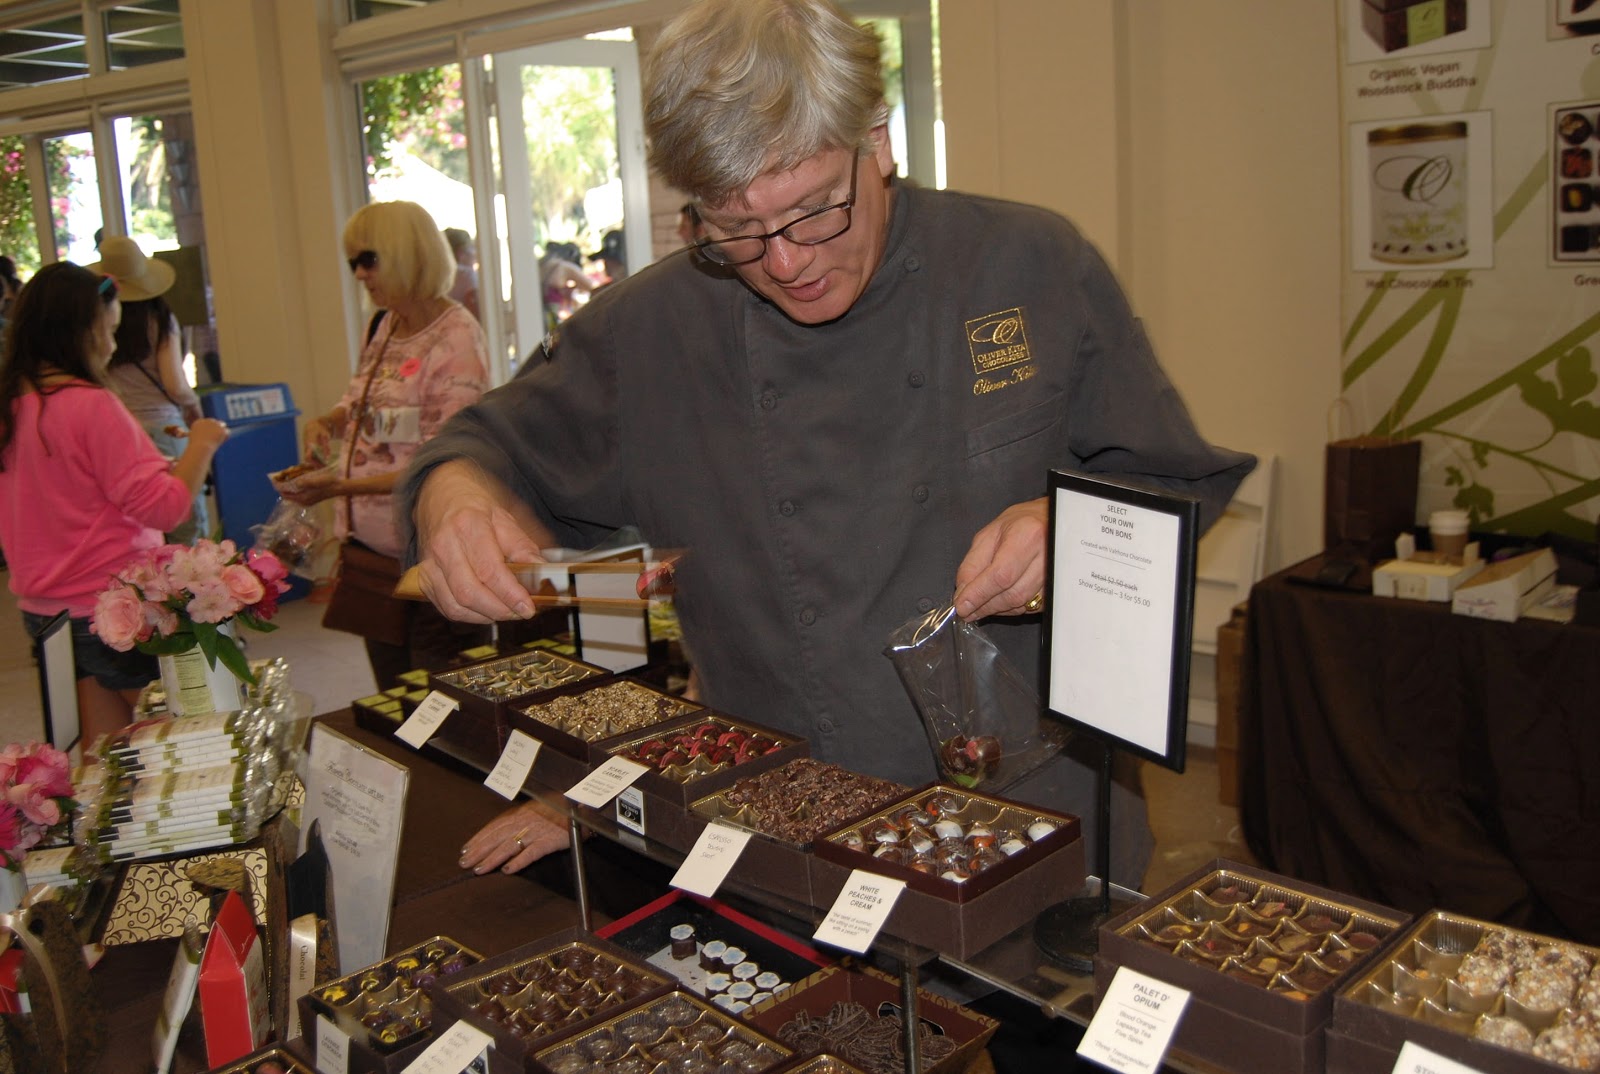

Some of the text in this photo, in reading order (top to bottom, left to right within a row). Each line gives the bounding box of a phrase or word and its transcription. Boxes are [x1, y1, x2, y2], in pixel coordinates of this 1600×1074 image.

[1369, 62, 1460, 82] Organic Vegan
[1358, 77, 1476, 97] Woodstock Buddha
[1390, 277, 1449, 289] Chocolate
[977, 344, 1026, 363] OLIVER KITA
[982, 352, 1025, 369] CHOCOLATES
[1107, 504, 1127, 516] SELECT
[1100, 514, 1134, 529] YOUR OWN
[1101, 525, 1132, 540] BON BONS
[1080, 539, 1098, 549] Created
[1129, 553, 1152, 565] Chocolate
[1078, 578, 1093, 589] Show
[1094, 583, 1113, 596] Special
[1119, 591, 1123, 599] 3
[1124, 593, 1133, 601] for
[1133, 596, 1151, 607] $5.00
[848, 890, 877, 903] PEACHES
[859, 884, 880, 895] WHITE
[850, 899, 873, 910] CREAM
[1133, 983, 1161, 998] PALET
[1133, 994, 1161, 1010] OPIUM
[1119, 1010, 1157, 1031] Blood Orange
[1115, 1028, 1143, 1046] Five Spice
[1140, 1028, 1152, 1039] Tea
